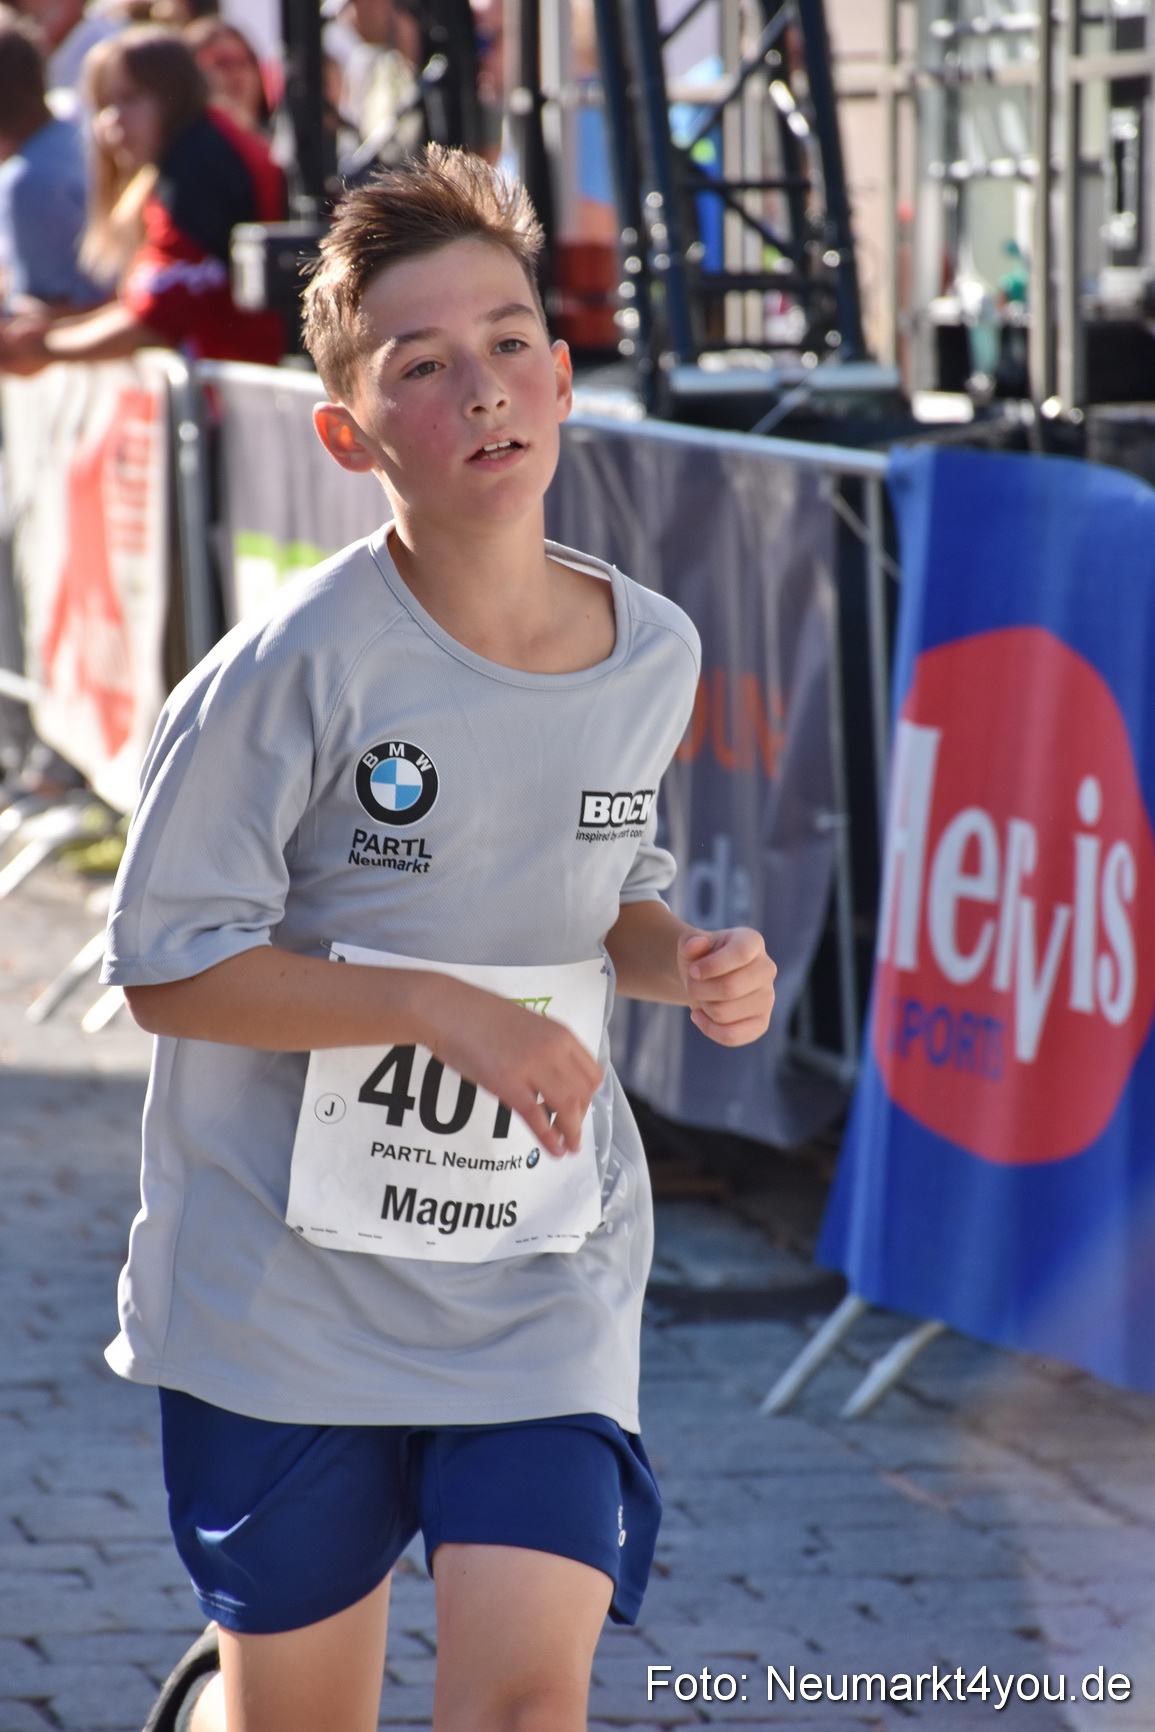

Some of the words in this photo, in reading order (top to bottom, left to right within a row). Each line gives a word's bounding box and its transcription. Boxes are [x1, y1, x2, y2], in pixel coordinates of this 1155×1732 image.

[362, 743, 432, 773] BMW
[352, 828, 432, 859] PARTL
[576, 829, 610, 843] inspired
[348, 850, 430, 873] Neumarkt
[324, 1101, 335, 1117] J
[371, 1141, 437, 1166] PARTL
[442, 1150, 523, 1171] Neumarkt
[381, 1184, 517, 1235] Magnus
